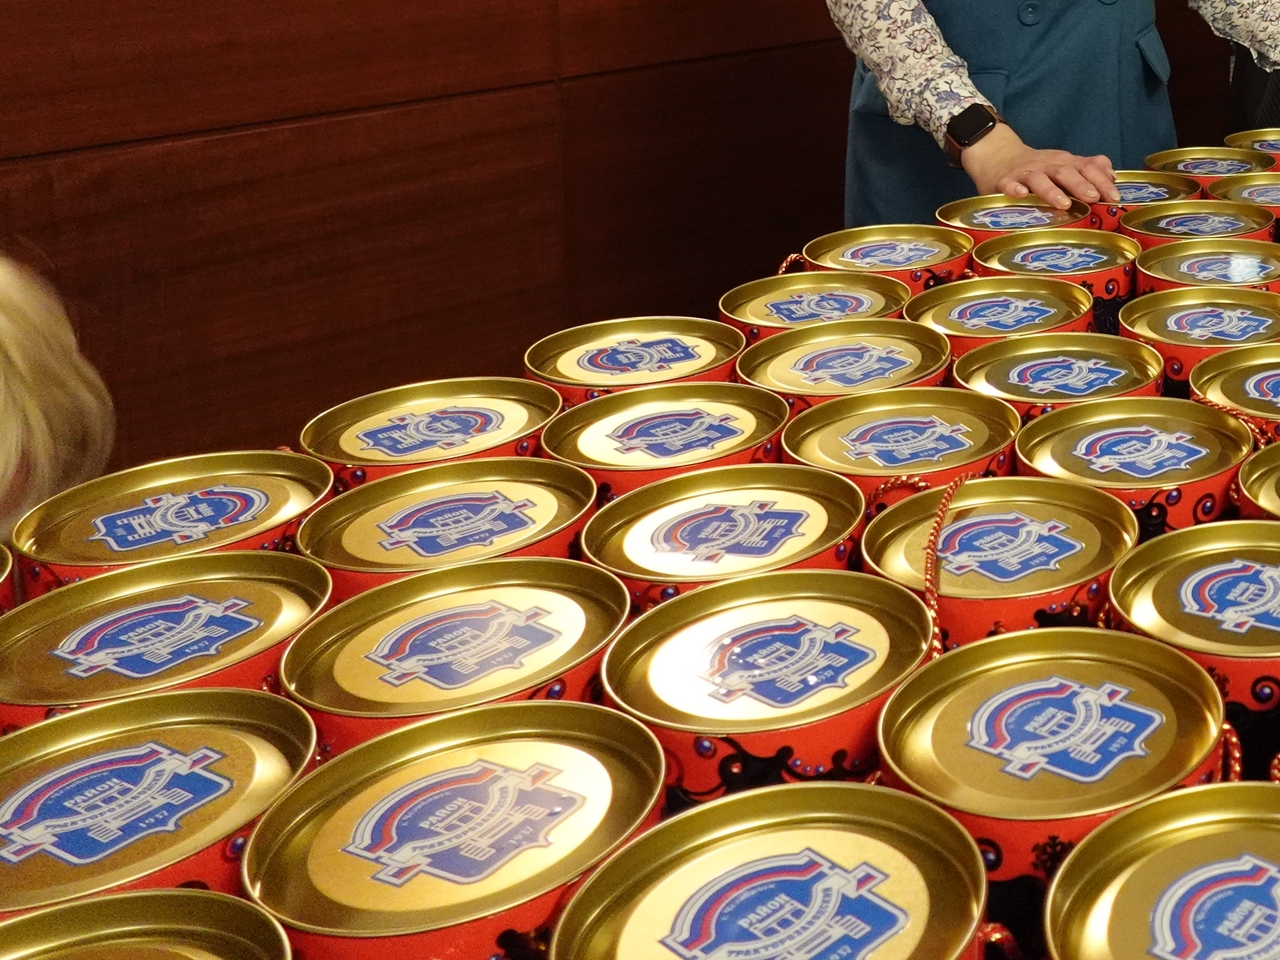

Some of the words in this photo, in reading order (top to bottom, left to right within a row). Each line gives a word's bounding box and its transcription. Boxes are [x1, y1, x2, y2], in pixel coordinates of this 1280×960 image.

[62, 777, 124, 809] РАЙОН
[138, 810, 170, 829] 1937
[419, 797, 470, 830] РАЙОН
[736, 893, 794, 931] РАЙОН
